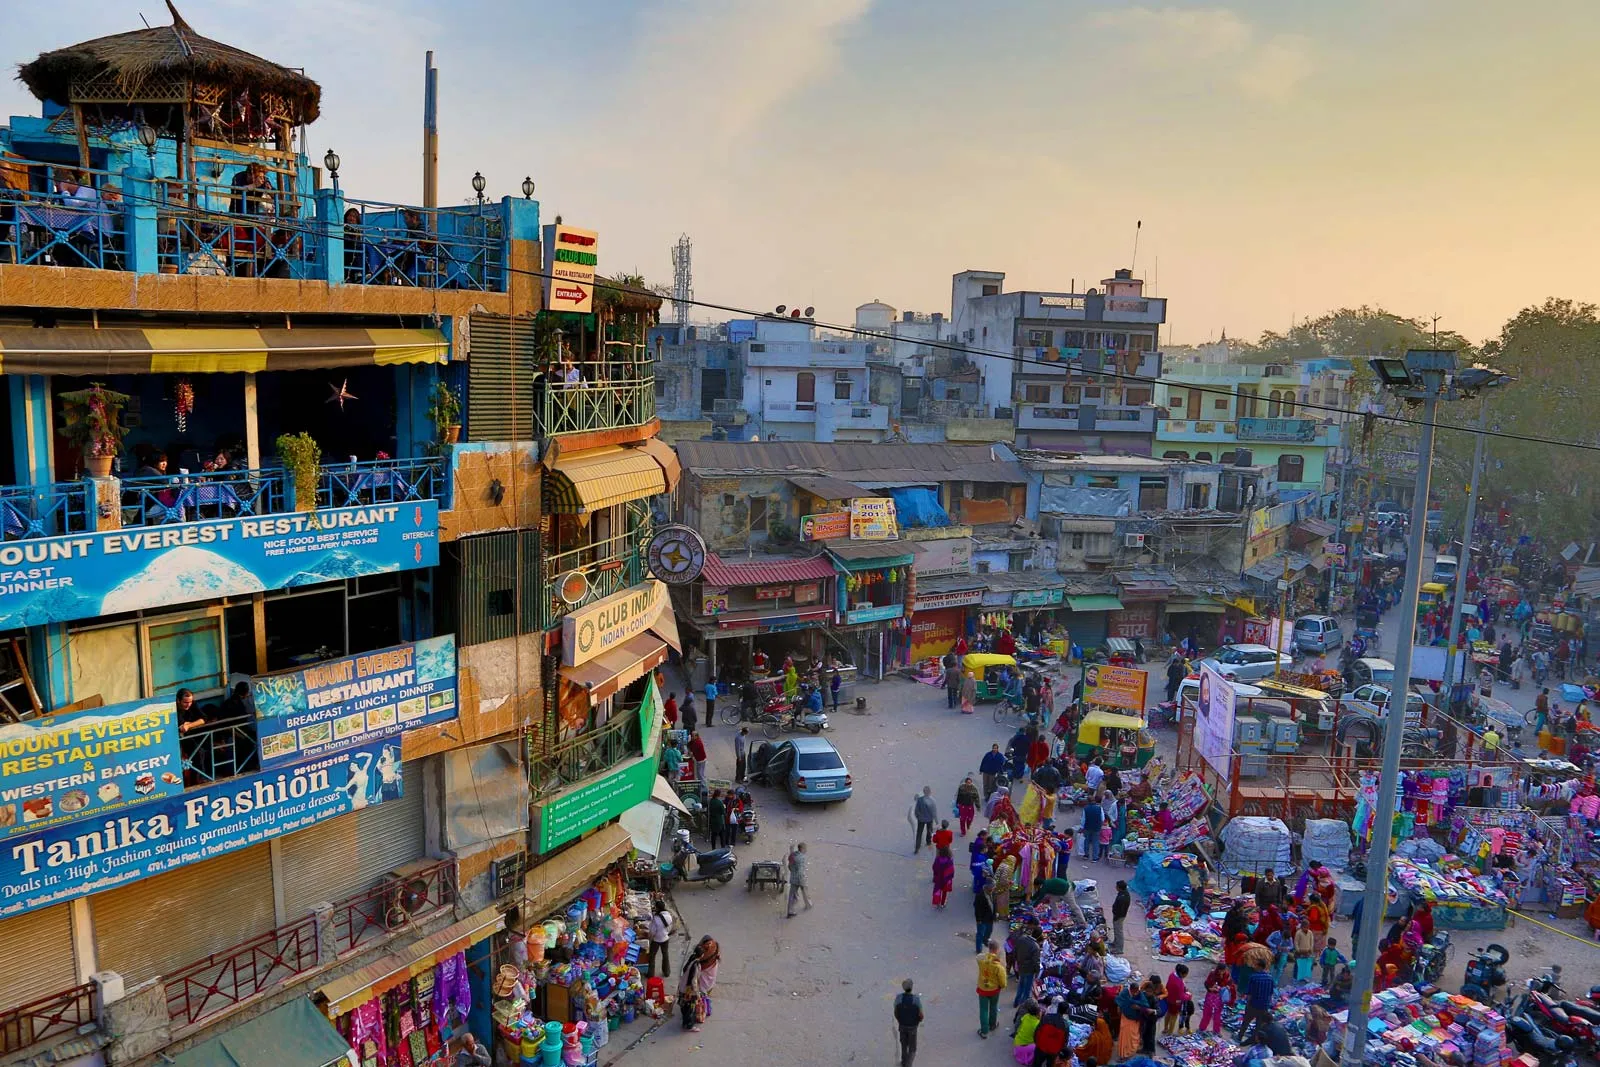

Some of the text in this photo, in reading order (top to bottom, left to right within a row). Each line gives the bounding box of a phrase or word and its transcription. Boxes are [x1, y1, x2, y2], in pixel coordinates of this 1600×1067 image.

[556, 290, 583, 299] ENTRANCE
[0, 507, 399, 567] OUNT EVEREST RESTAURANT
[263, 528, 379, 550] NICE FOOD BEST SERVICE
[265, 548, 285, 557] FREE
[285, 545, 307, 555] HOME
[307, 541, 340, 552] DELIVERY
[598, 599, 629, 632] CLUB
[923, 600, 945, 609] PAINTS
[600, 626, 626, 648] INDIAN
[912, 621, 936, 632] asian
[924, 625, 954, 639] paints
[303, 646, 414, 691] MOUNT EVEREST
[286, 682, 434, 729] BREAKFAST LUNCH DINNER
[307, 669, 416, 710] RESTAURANT
[79, 709, 173, 742] EVEREST
[303, 745, 322, 757] Free
[324, 738, 350, 752] Home
[351, 729, 384, 745] Delivery
[384, 723, 403, 737] Upto
[2, 730, 165, 777] RESTAURENT
[84, 761, 95, 771] &
[293, 753, 350, 776] 9810183192
[1, 754, 170, 802] WESTERN BAKERY
[12, 769, 330, 875] Tanika Fashion
[1, 791, 341, 898] Deals in: High Fashion sequins garments belly dance dresses
[0, 903, 24, 916] -mail:
[167, 855, 181, 867] 2nd
[248, 831, 263, 843] Main
[423, 974, 434, 984] SIL
